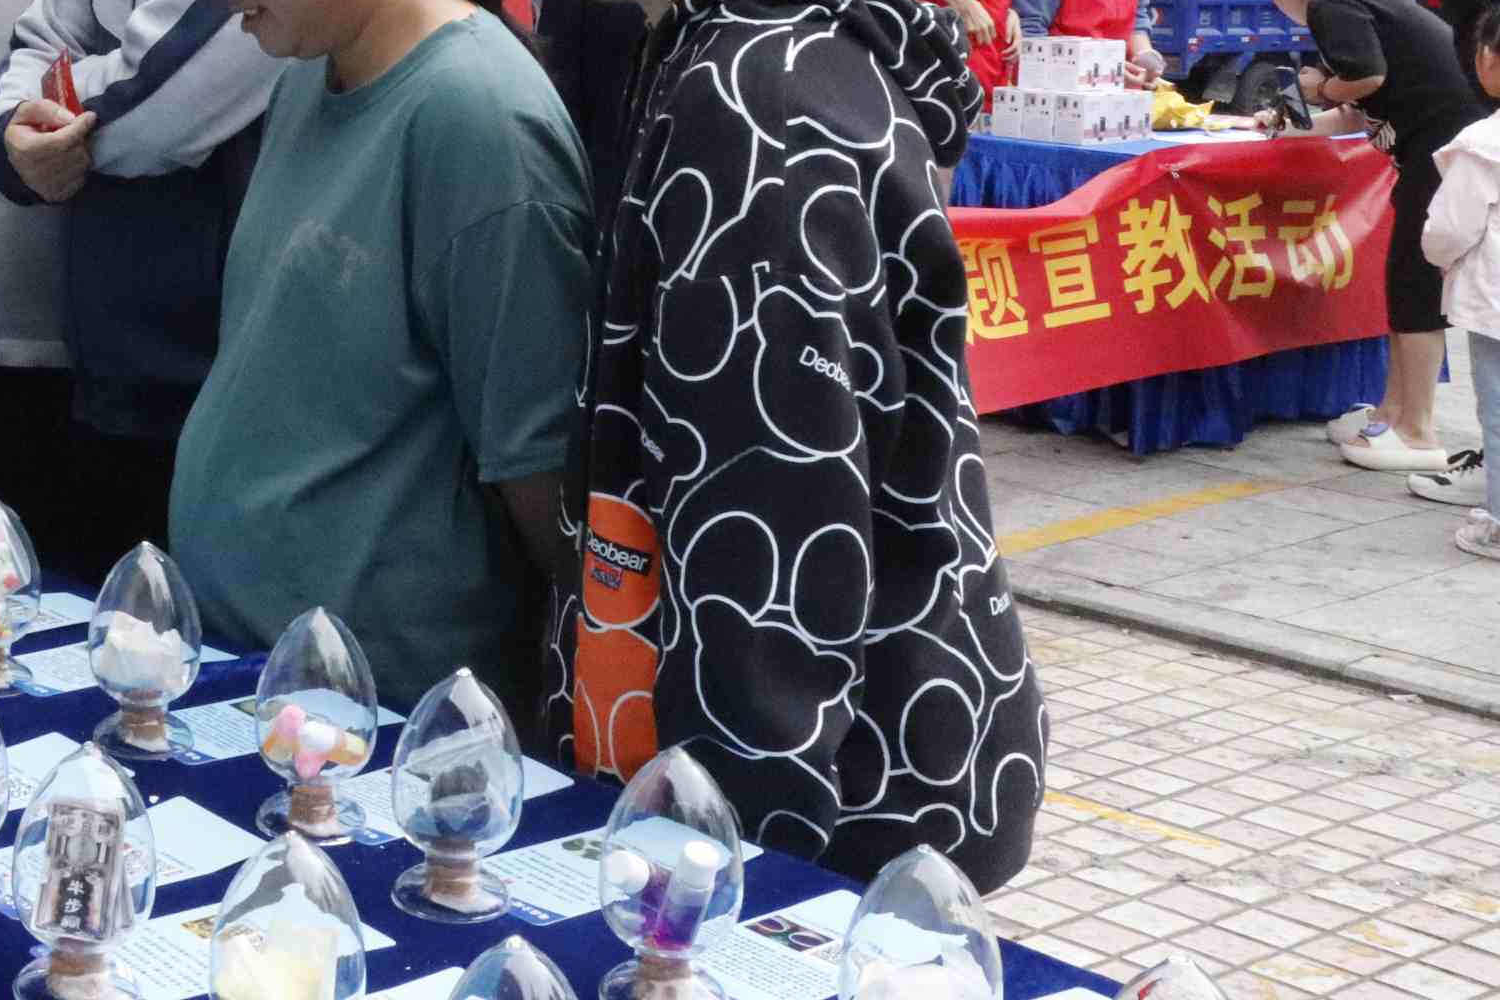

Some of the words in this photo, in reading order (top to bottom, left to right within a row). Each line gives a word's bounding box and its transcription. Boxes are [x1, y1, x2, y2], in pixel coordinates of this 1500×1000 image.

[965, 193, 1354, 345] 题宣教活动
